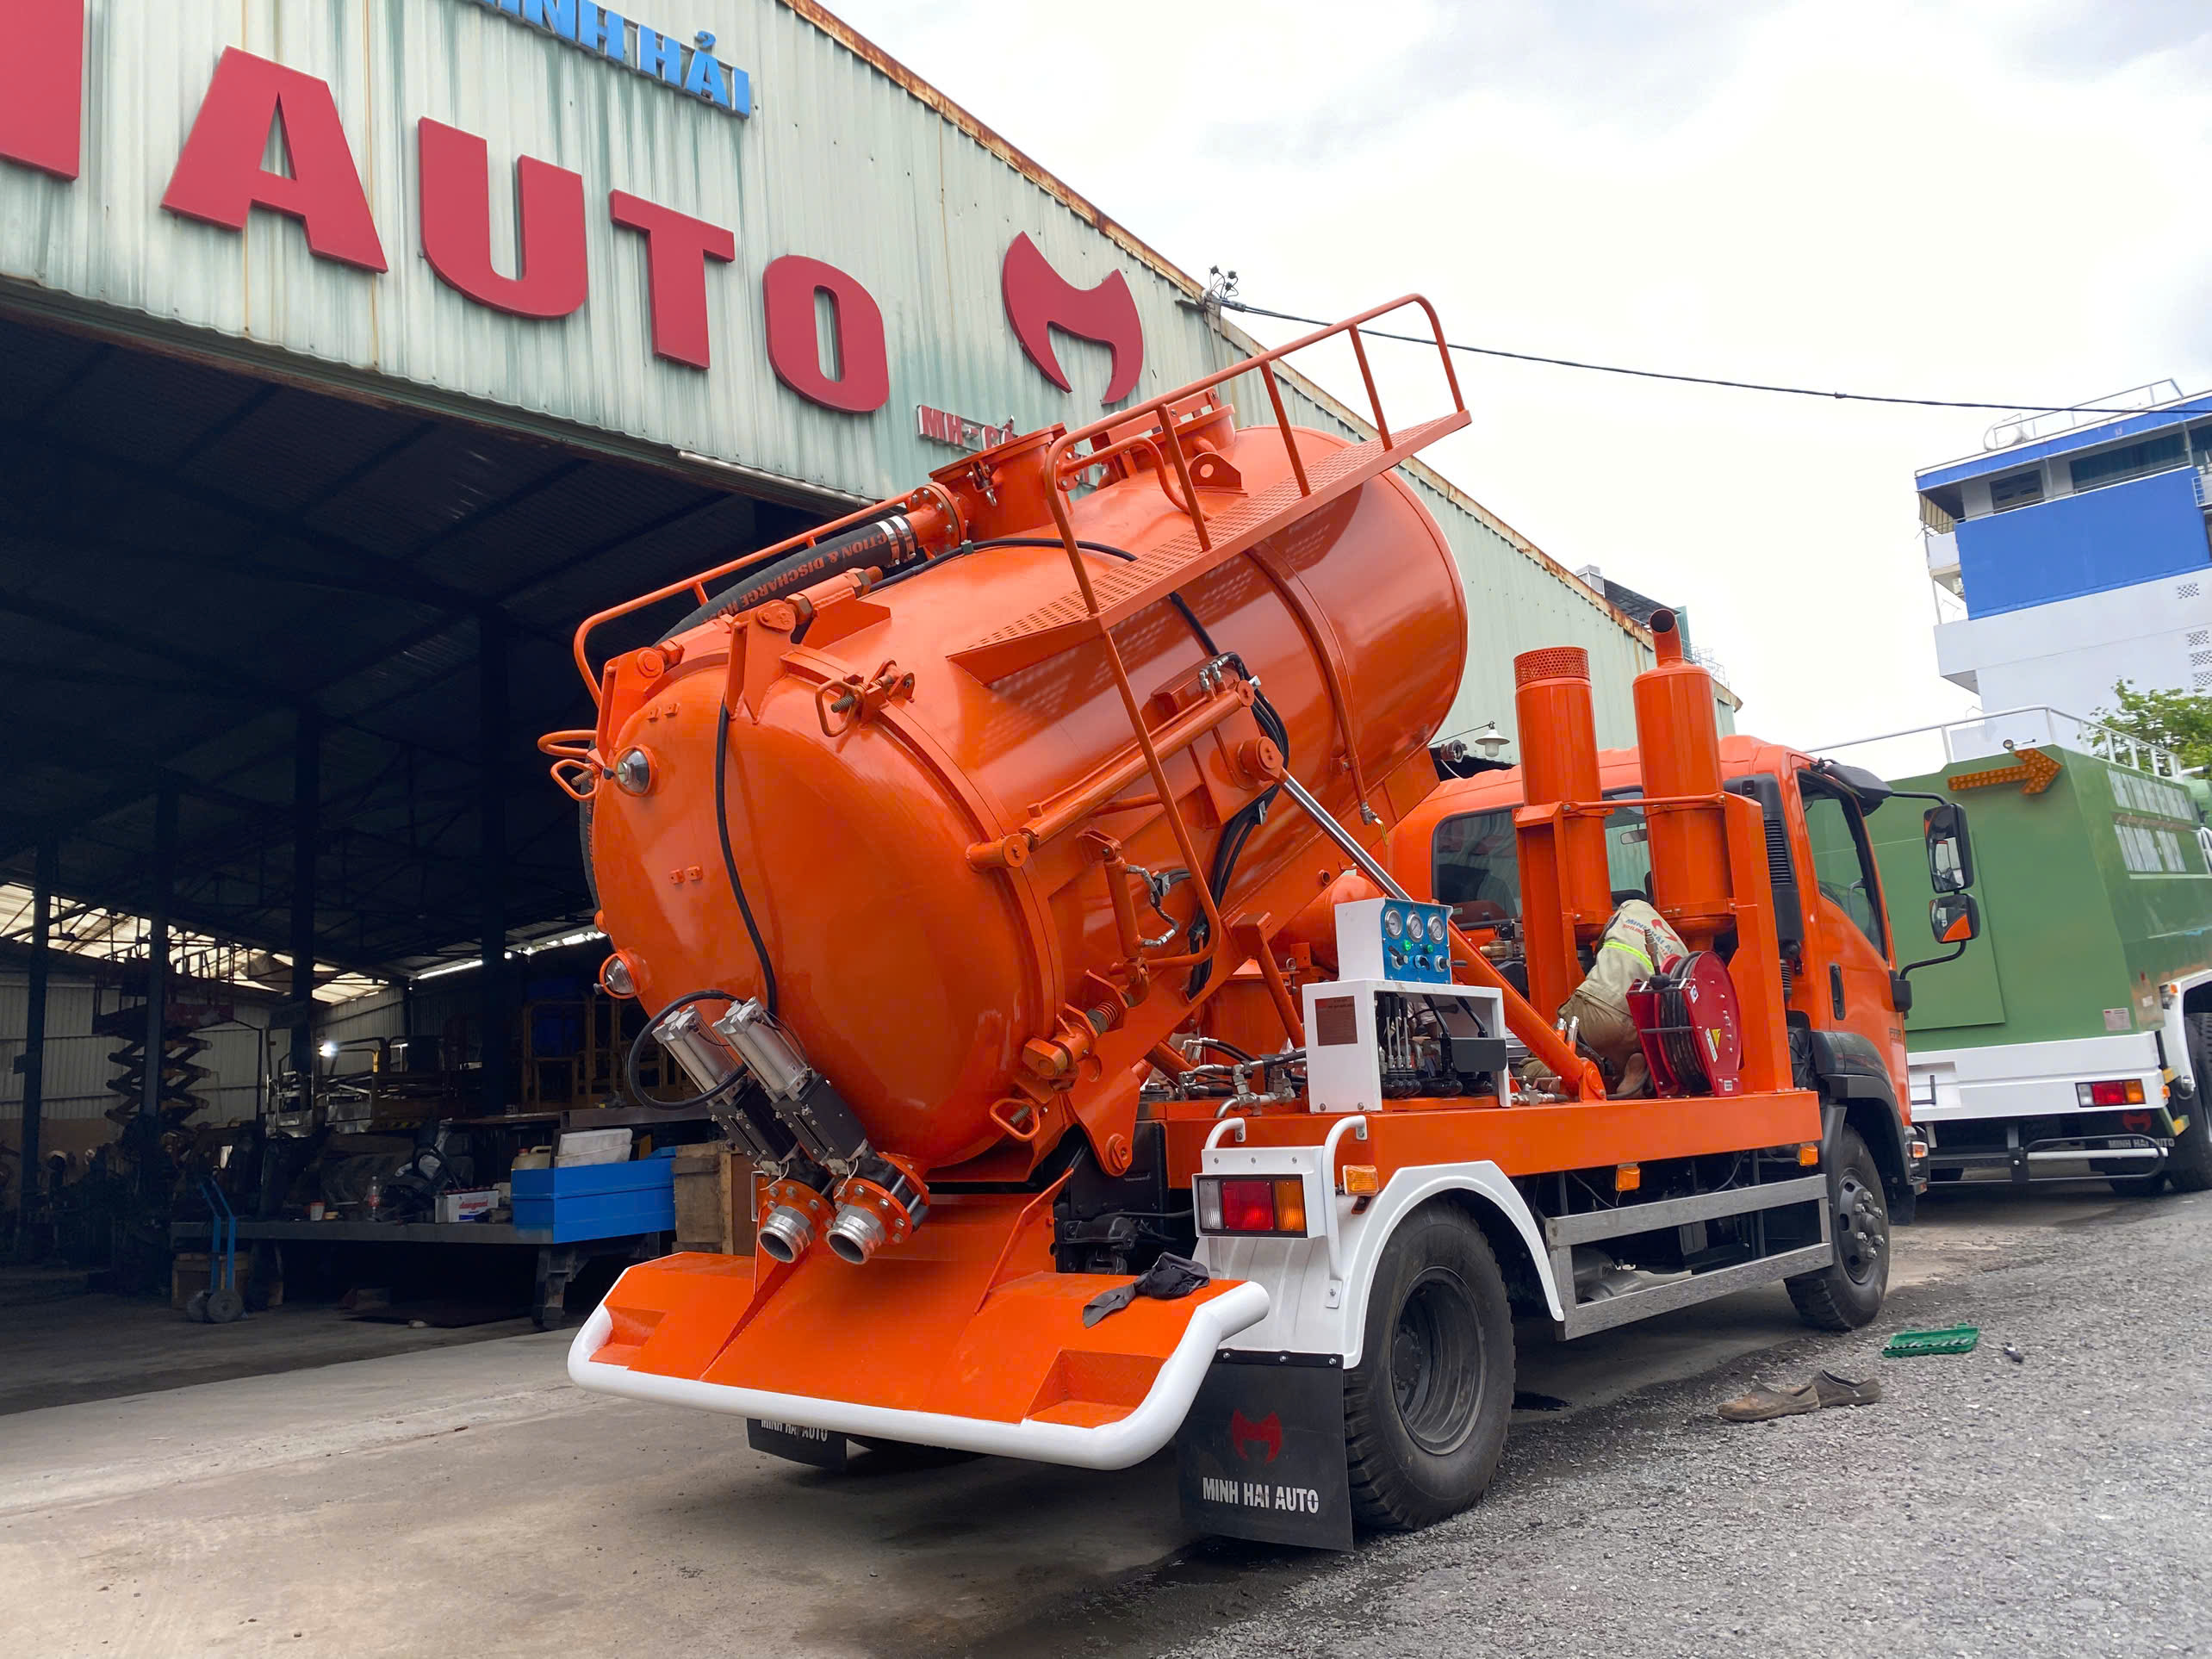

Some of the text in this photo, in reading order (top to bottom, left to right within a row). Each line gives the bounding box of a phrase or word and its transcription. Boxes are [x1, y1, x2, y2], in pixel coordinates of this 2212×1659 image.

[636, 30, 749, 119] HẢI
[160, 46, 890, 413] AUTO
[827, 550, 839, 563] &
[841, 527, 904, 558] SCTION
[740, 556, 825, 606] DISCHARGE
[1202, 1477, 1319, 1513] MINH HAI AUTO
